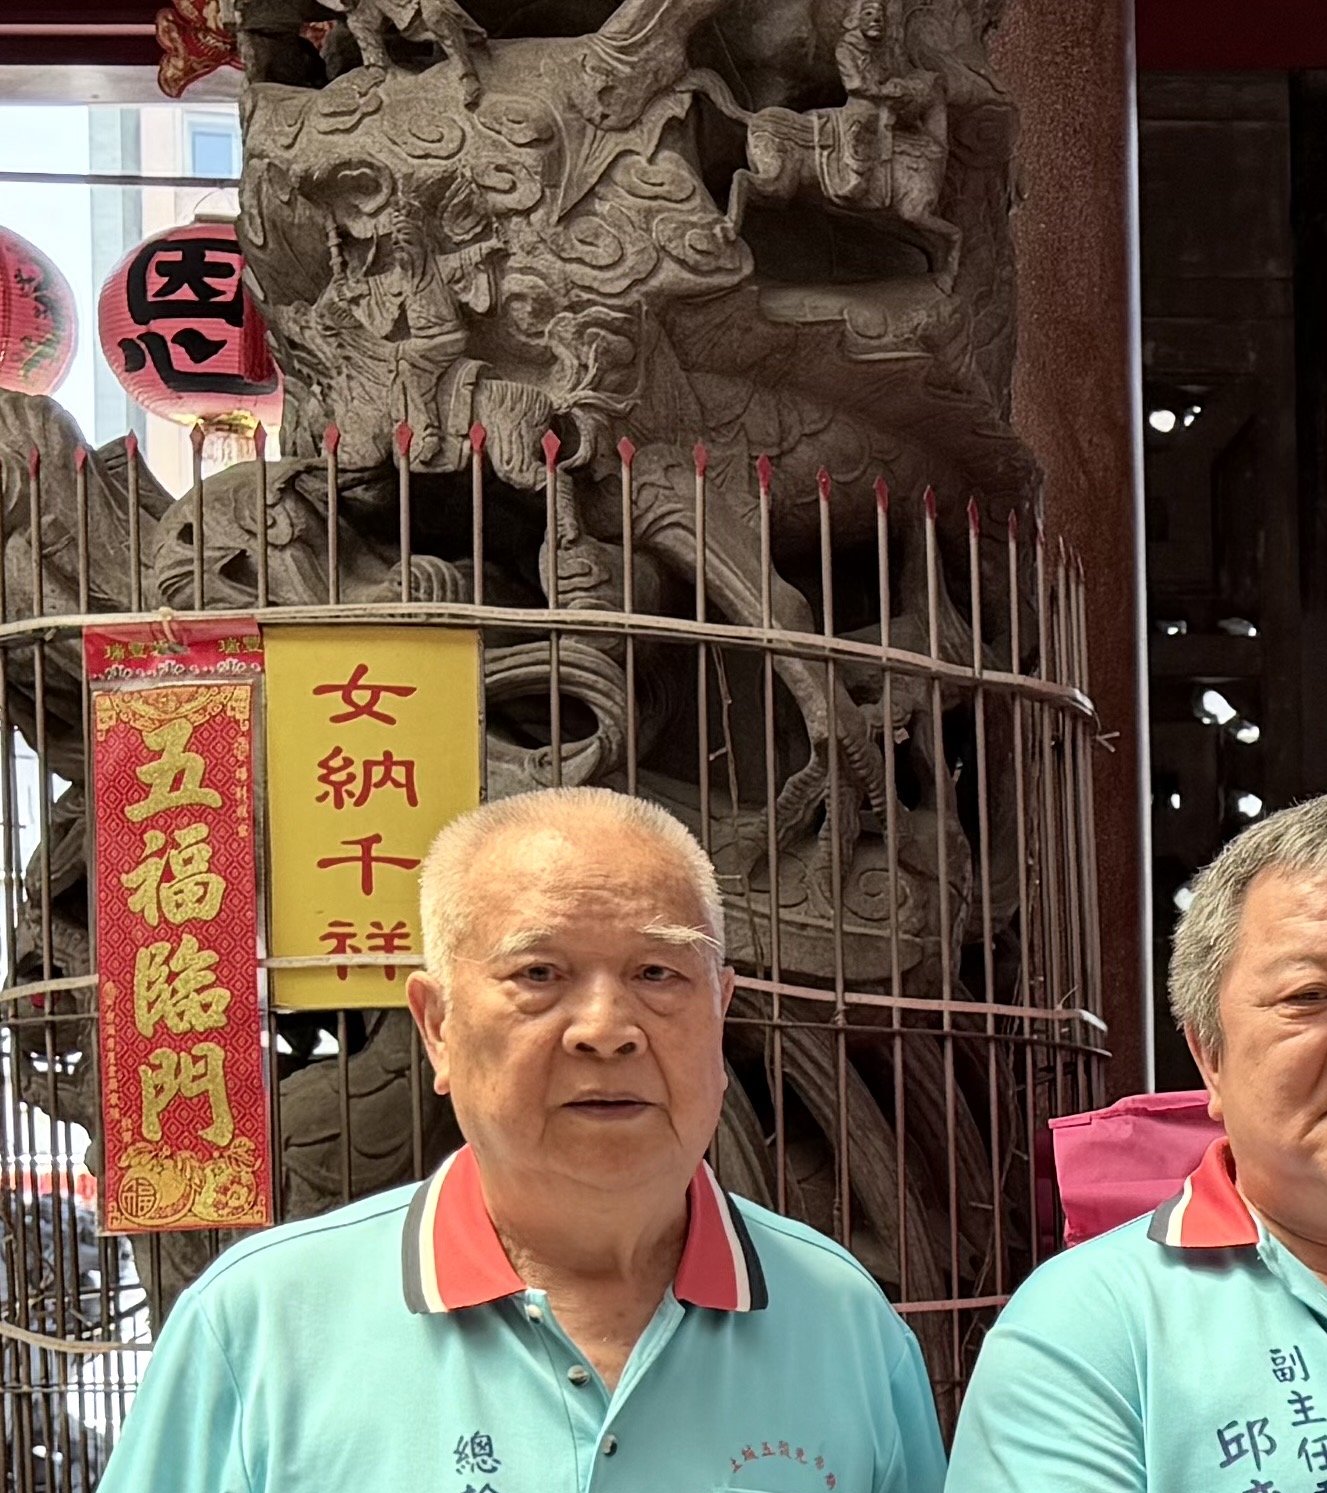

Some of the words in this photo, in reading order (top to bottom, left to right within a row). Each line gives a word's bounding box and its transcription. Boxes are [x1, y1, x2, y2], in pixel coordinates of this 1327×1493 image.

[117, 237, 280, 396] 恩
[124, 718, 235, 1149] 五福臨門
[312, 662, 421, 982] 女納千祥
